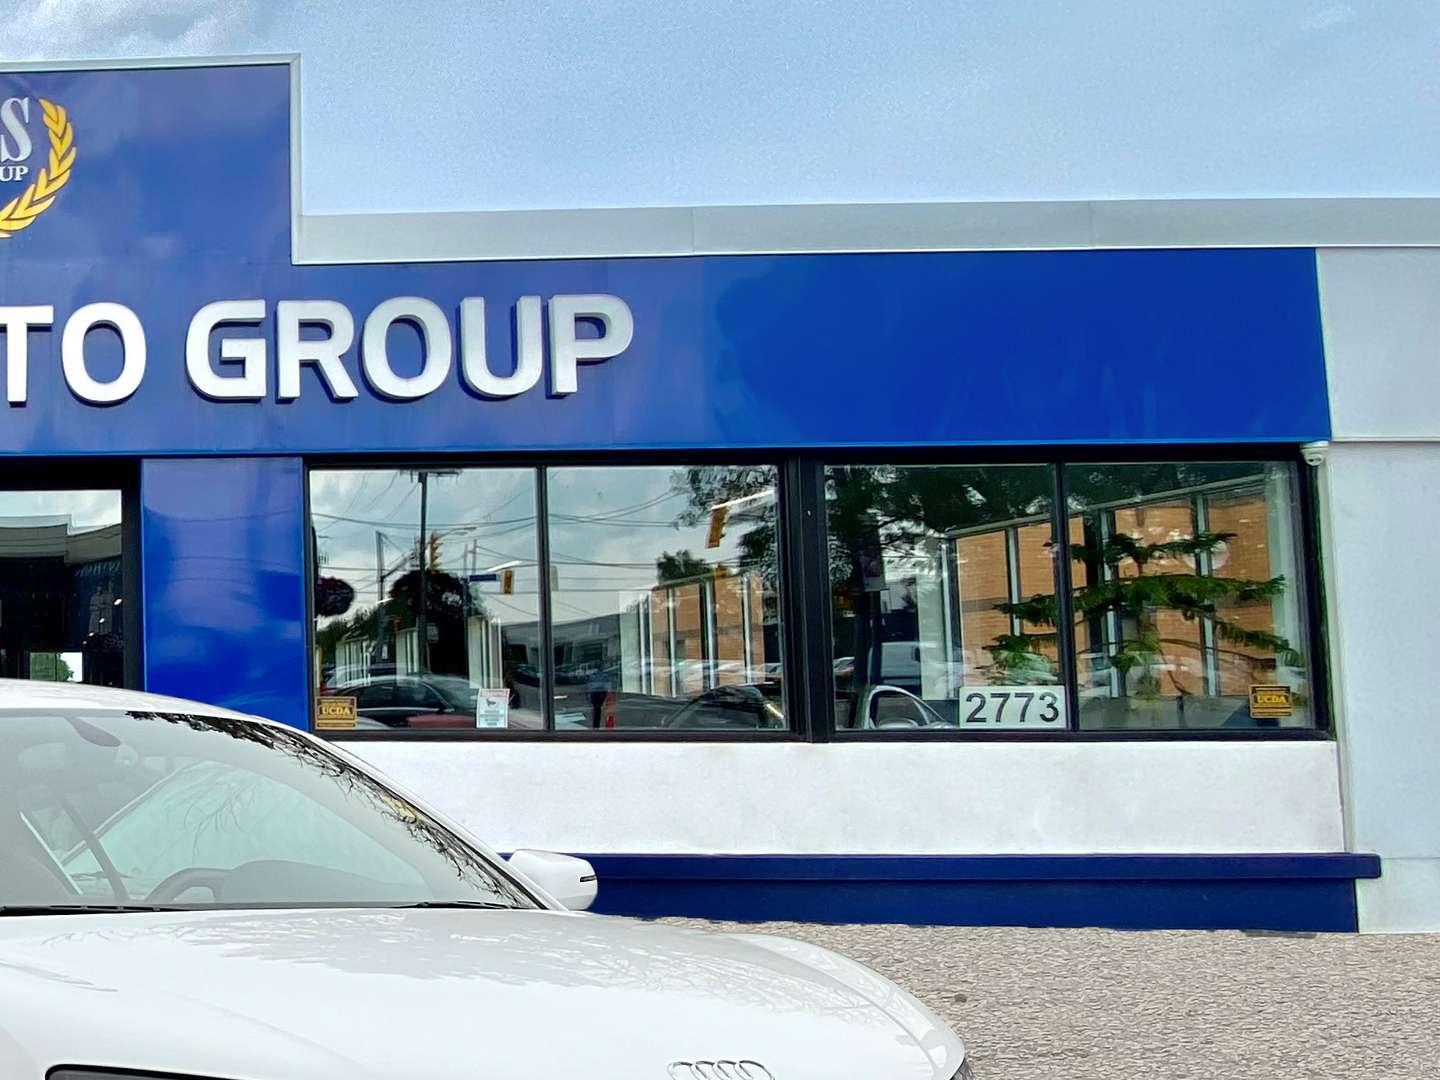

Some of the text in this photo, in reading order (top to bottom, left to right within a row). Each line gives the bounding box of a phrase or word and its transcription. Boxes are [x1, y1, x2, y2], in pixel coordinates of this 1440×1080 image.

[184, 296, 635, 404] GROUP
[965, 691, 1060, 723] 2773
[1257, 694, 1288, 703] UCDA
[321, 706, 351, 715] UCDA
